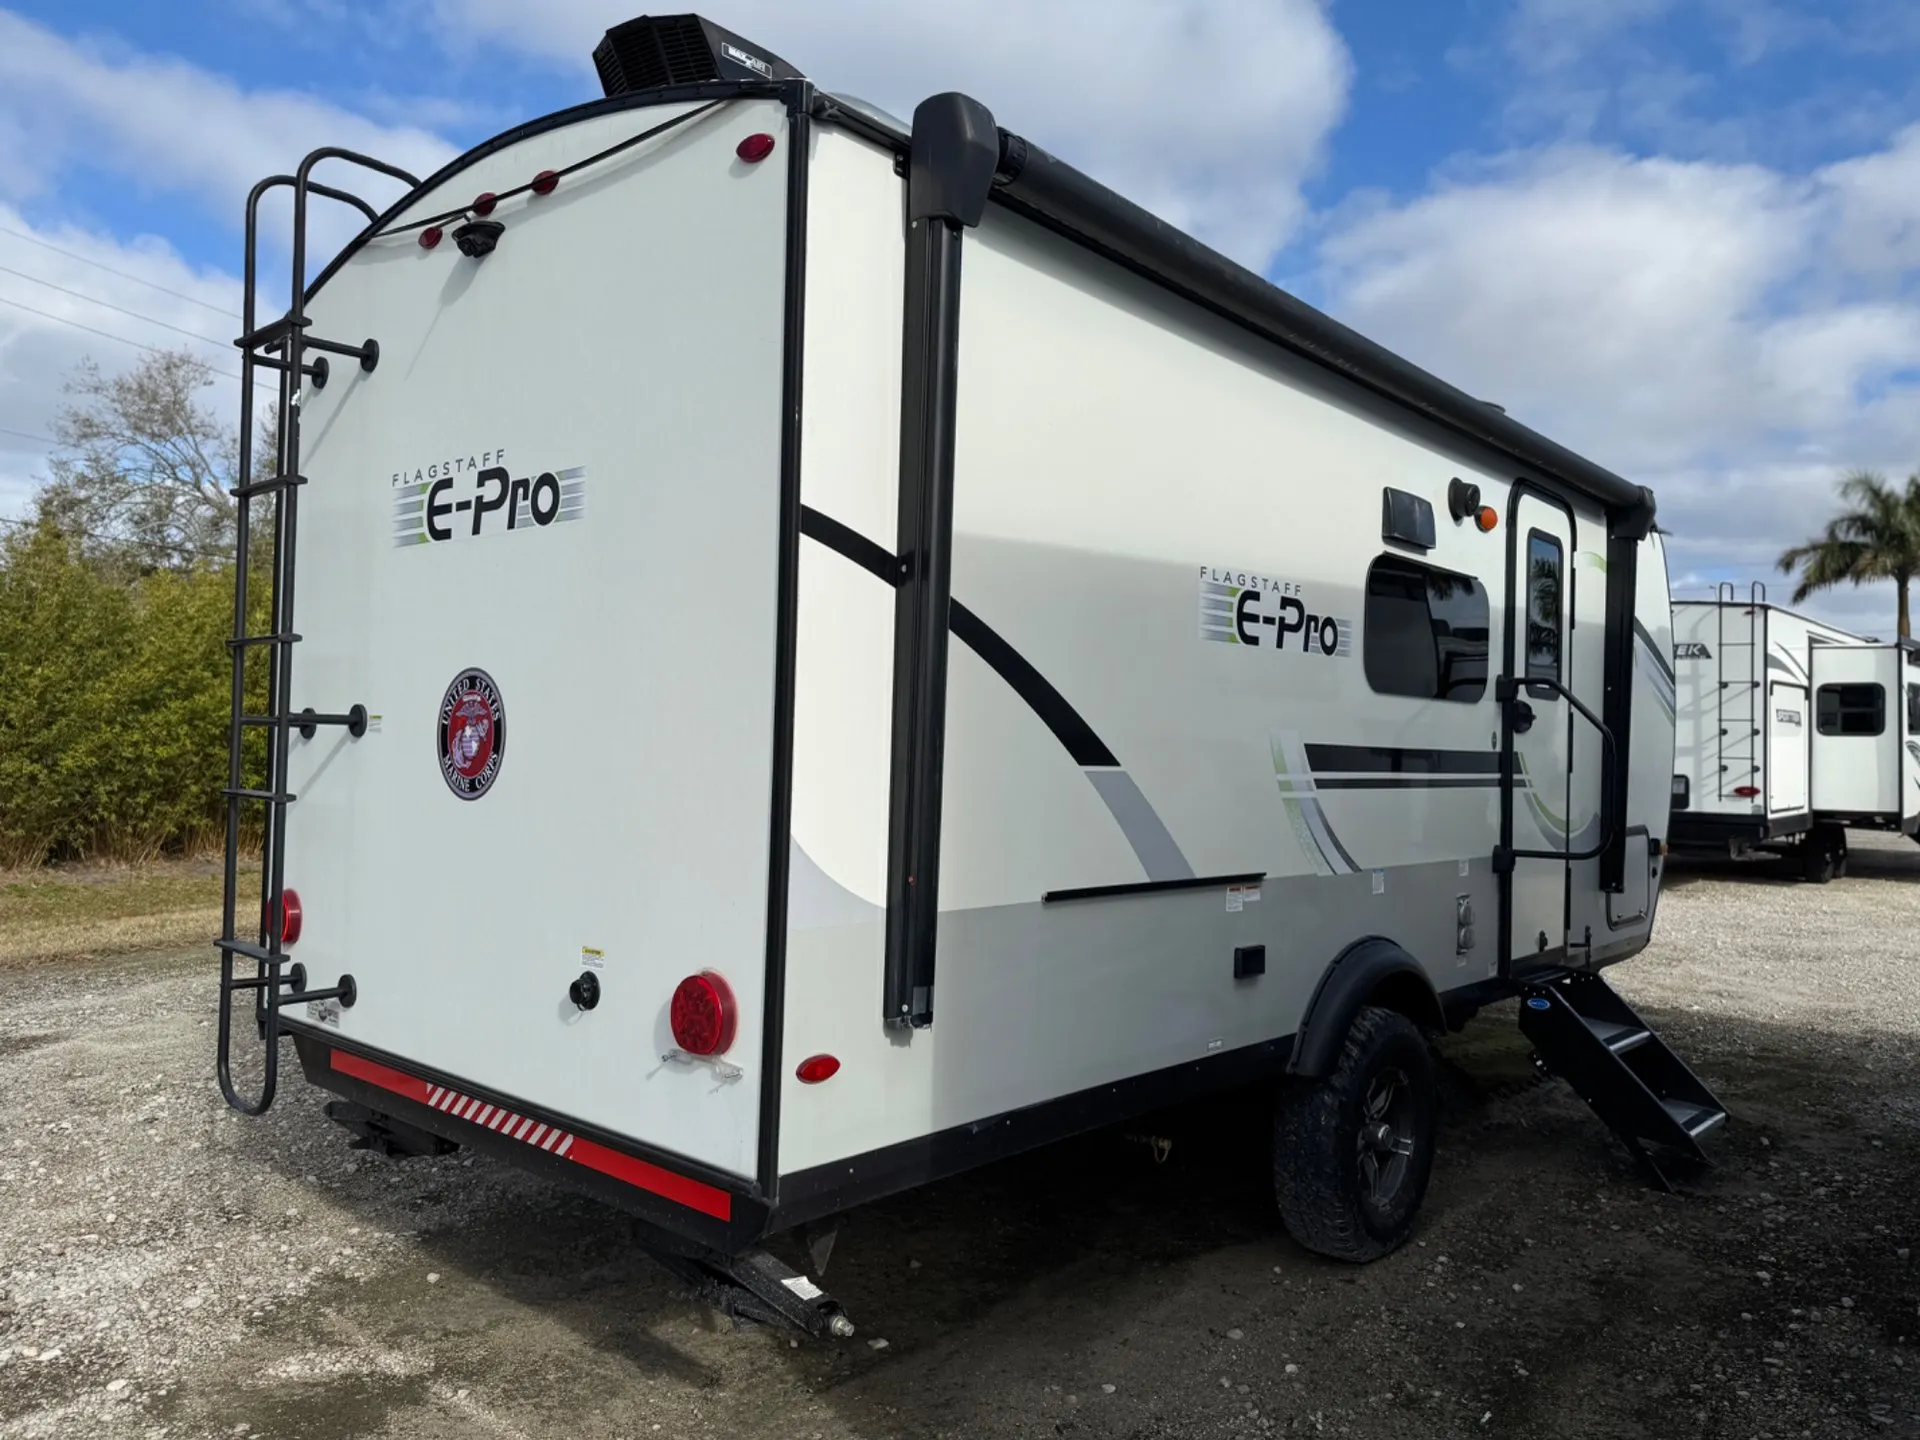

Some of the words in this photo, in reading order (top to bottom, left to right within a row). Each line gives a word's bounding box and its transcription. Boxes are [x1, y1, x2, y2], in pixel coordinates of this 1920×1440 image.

[392, 449, 505, 487] FLAGSTAFF
[426, 466, 560, 541] E-Pro
[1200, 566, 1302, 596] FLAGSTAFF
[1236, 589, 1338, 656] E-Pro
[1676, 644, 1702, 656] EK
[442, 678, 470, 725] UNITED
[475, 678, 501, 722] STATES
[443, 753, 470, 792] MARINE
[475, 753, 499, 790] CORPS
